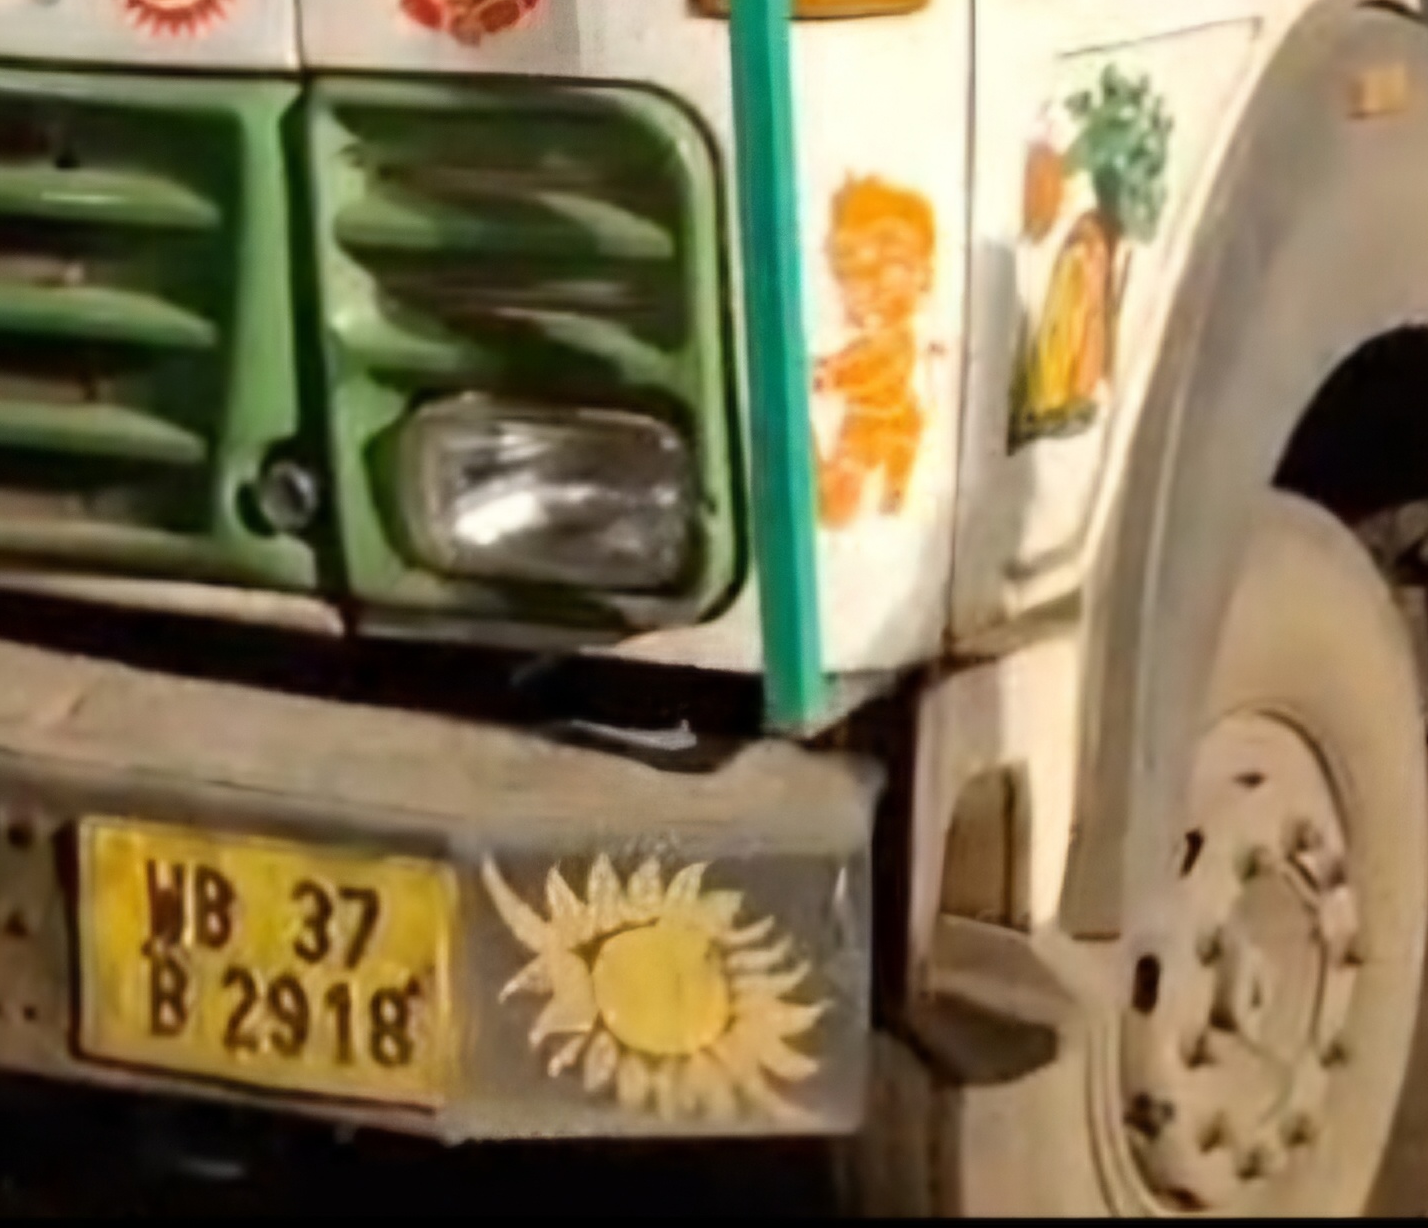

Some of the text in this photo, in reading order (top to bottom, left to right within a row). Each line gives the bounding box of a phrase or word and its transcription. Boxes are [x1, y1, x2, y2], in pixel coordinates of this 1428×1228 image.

[146, 858, 380, 970] WB 37
[149, 954, 415, 1067] B 2918
